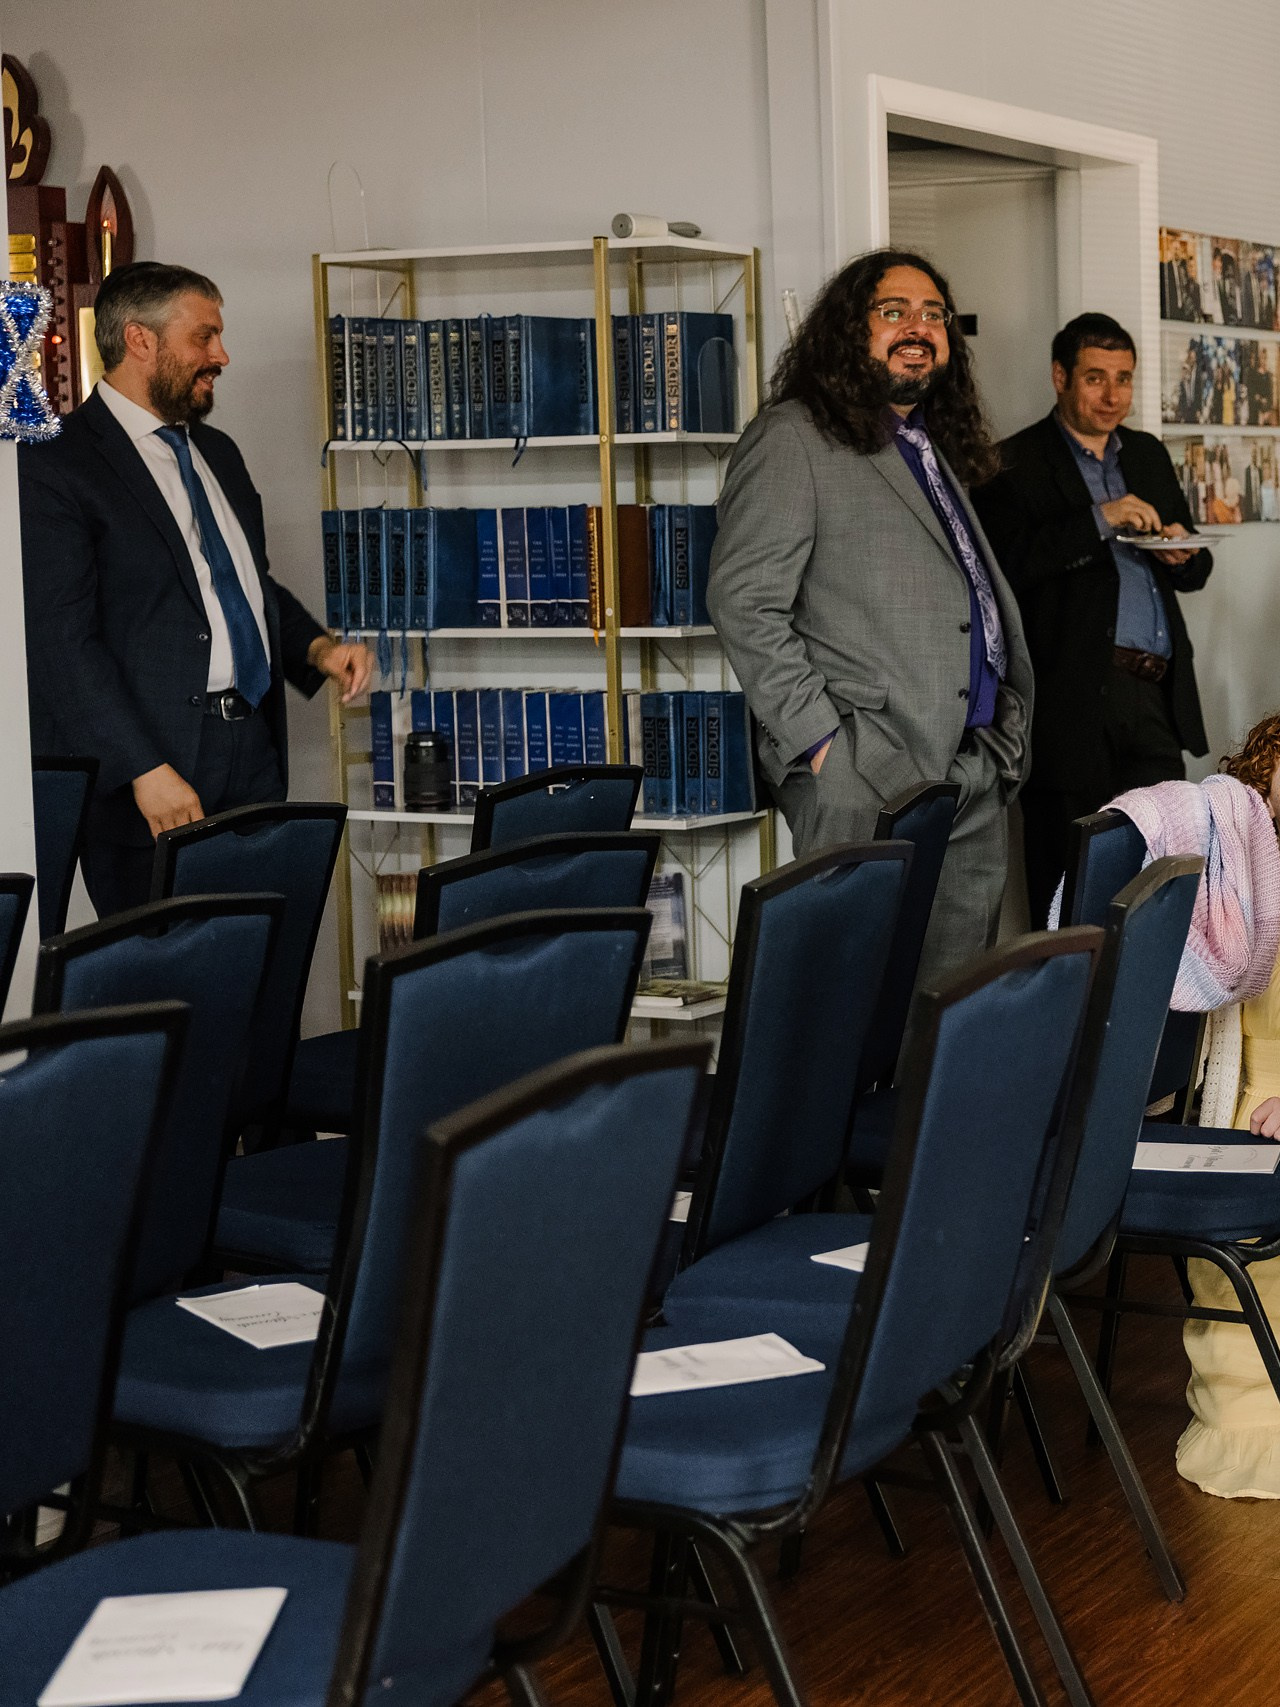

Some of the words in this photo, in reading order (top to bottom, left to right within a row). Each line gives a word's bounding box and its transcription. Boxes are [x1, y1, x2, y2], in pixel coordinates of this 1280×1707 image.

[366, 346, 378, 406] SIDDUR
[383, 346, 396, 406] SIDDUR
[405, 346, 418, 406] SIDDUR
[430, 341, 442, 403] SIDDUR
[494, 341, 506, 402] SIDDUR
[643, 339, 656, 398] SIDDUR
[667, 336, 680, 397] SIDDUR
[326, 534, 339, 592] SIDDUR
[346, 535, 360, 592] SIDDUR
[676, 529, 688, 590] SIDDUR
[644, 719, 656, 776] SIDDUR
[658, 719, 670, 777] SIDDUR
[687, 719, 699, 777] SIDDUR
[708, 718, 720, 777] SIDDUR
